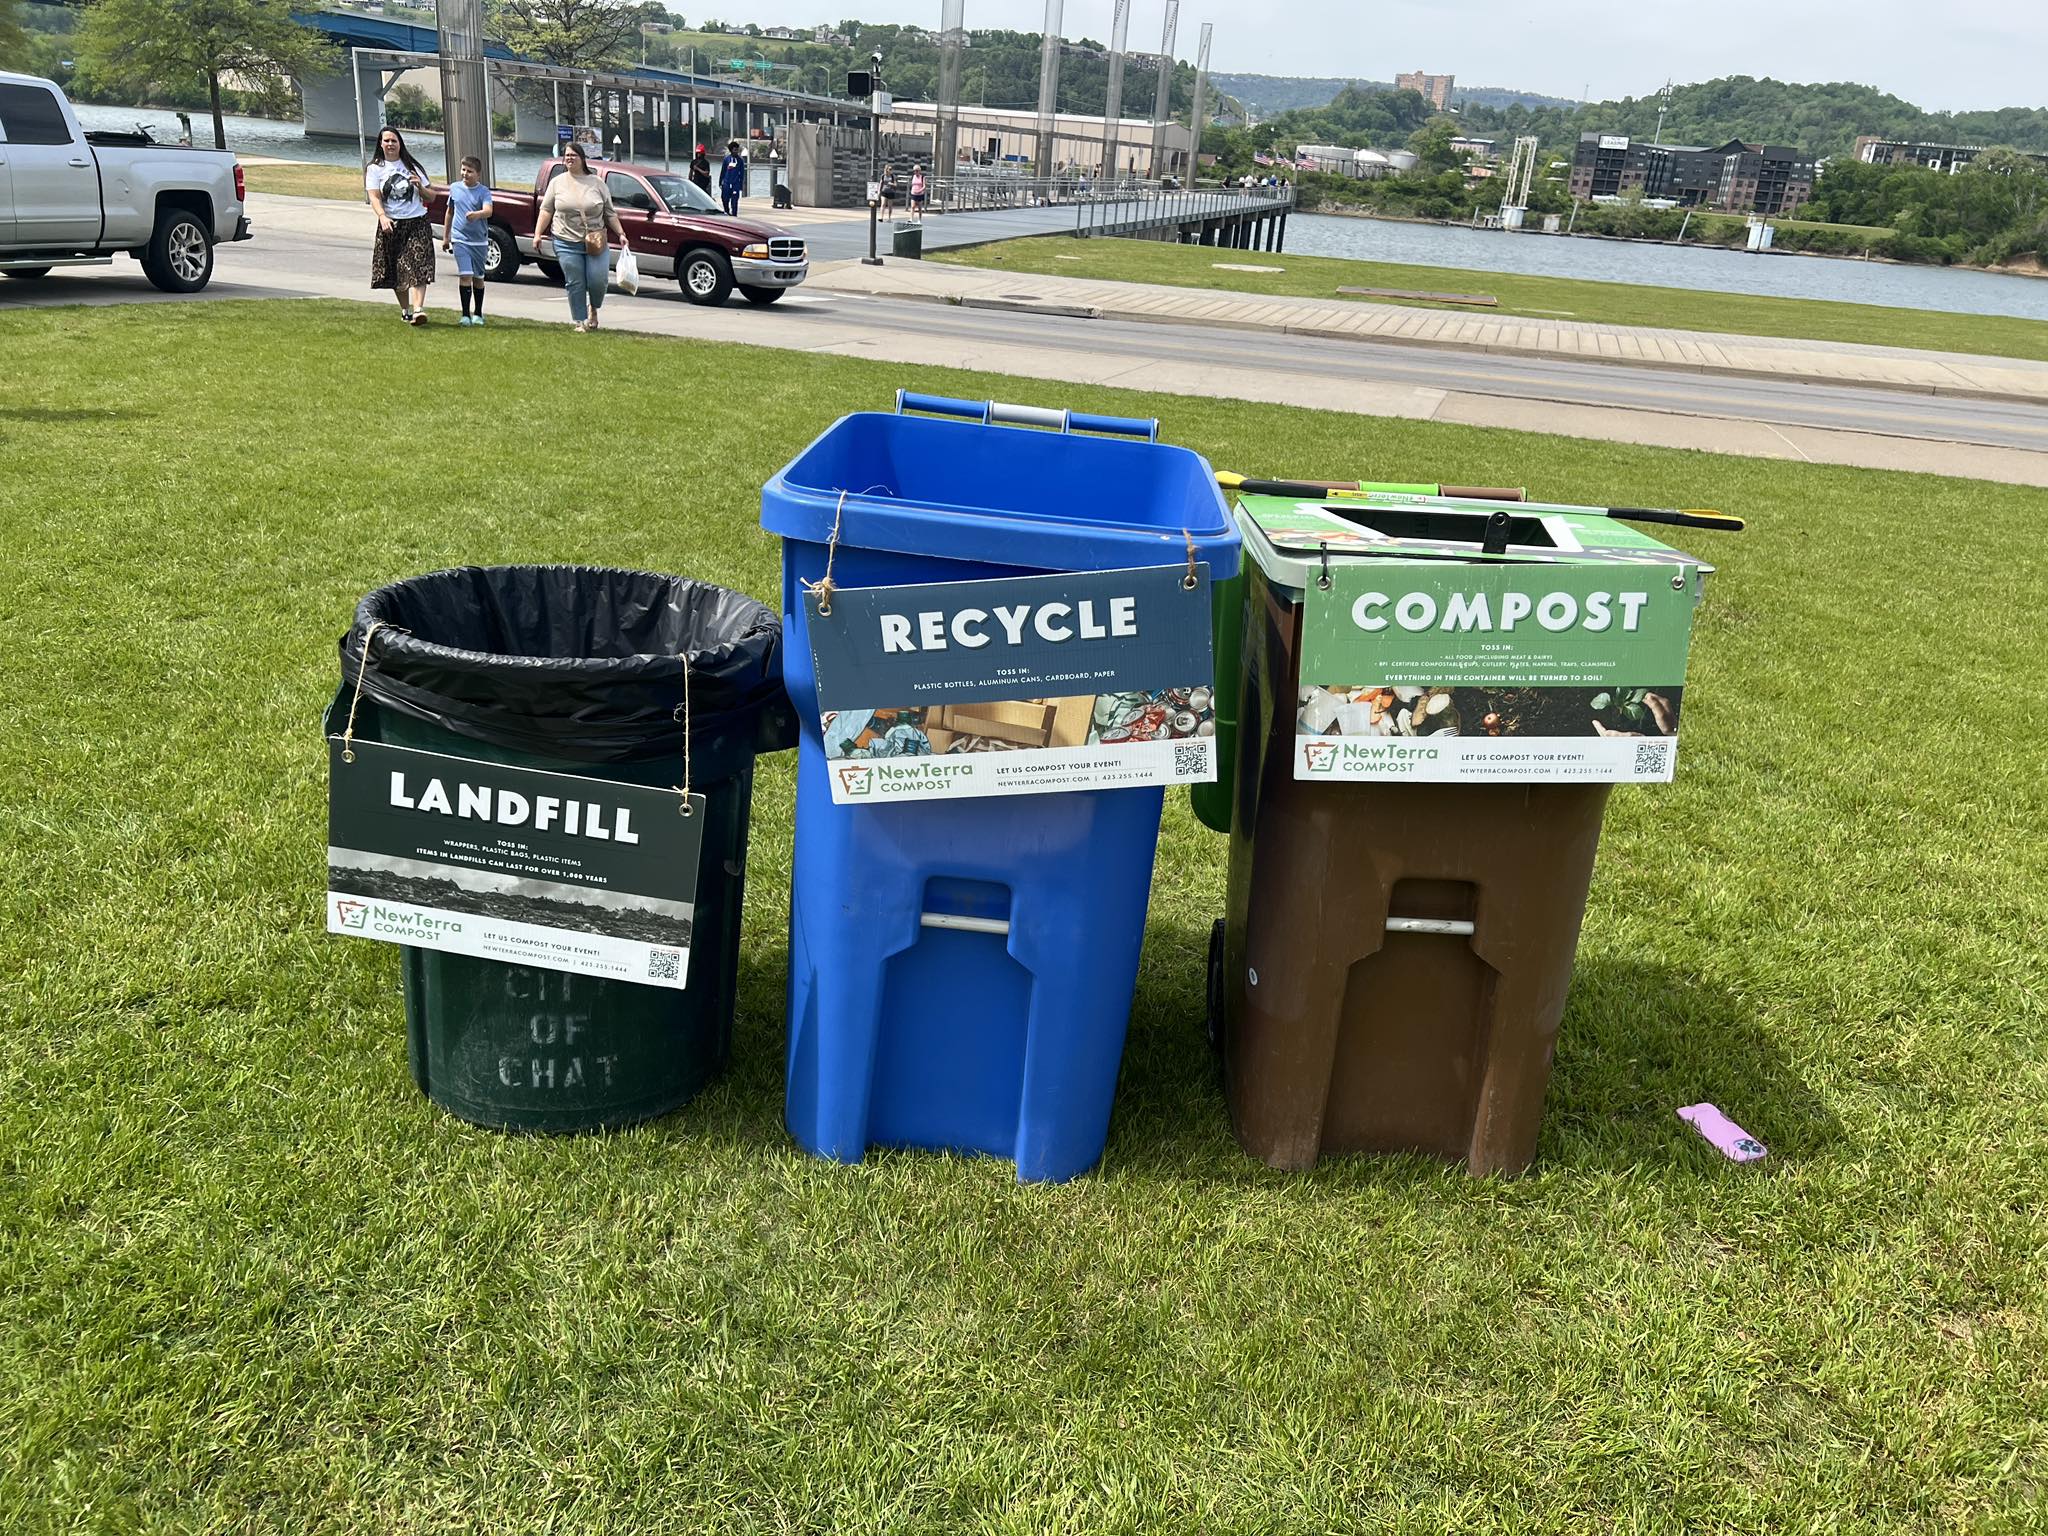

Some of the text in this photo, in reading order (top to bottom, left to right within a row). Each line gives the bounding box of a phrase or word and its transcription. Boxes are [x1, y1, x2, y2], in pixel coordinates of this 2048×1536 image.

[1351, 591, 1649, 633] COMPOST
[880, 596, 1138, 653] RECYCLE
[913, 670, 1115, 690] PLASTIC BOTTLES, ALUMINUM CANS, CARDBOARD, PAPER
[1343, 743, 1439, 760] NewTerra
[878, 763, 974, 780] NewTerra
[1025, 764, 1067, 773] COMPOST
[1069, 762, 1092, 770] YOUR
[1093, 760, 1122, 768] EVENT!
[1343, 762, 1415, 772] COMPOST
[880, 779, 952, 793] COMPOST
[998, 776, 1090, 787] NEWTERRACOMPOST.COM
[390, 771, 639, 845] LANDFILL
[443, 839, 582, 867] WRAPPERS, PLASTIC BAGS, PLASTIC ITEMS
[497, 840, 529, 851] TOSS IN:
[416, 847, 438, 857] ITEMS
[450, 853, 487, 865] LANDFILLS
[488, 859, 504, 867] CAN
[506, 862, 523, 870] LAST
[525, 865, 539, 873] FOR
[541, 868, 560, 876] OVER
[562, 871, 583, 880] 1,000
[585, 874, 607, 884] YEARS
[374, 905, 463, 933] NewTerra
[374, 922, 441, 941] COMPOST
[483, 932, 496, 940] LET
[510, 936, 549, 948] COMPOST
[551, 943, 572, 952] YOUR
[574, 946, 600, 957] EVENT!
[483, 944, 569, 963] NEWTERRACOMPOST.COM
[530, 1013, 589, 1046] OF
[498, 1054, 618, 1089] CHAT
